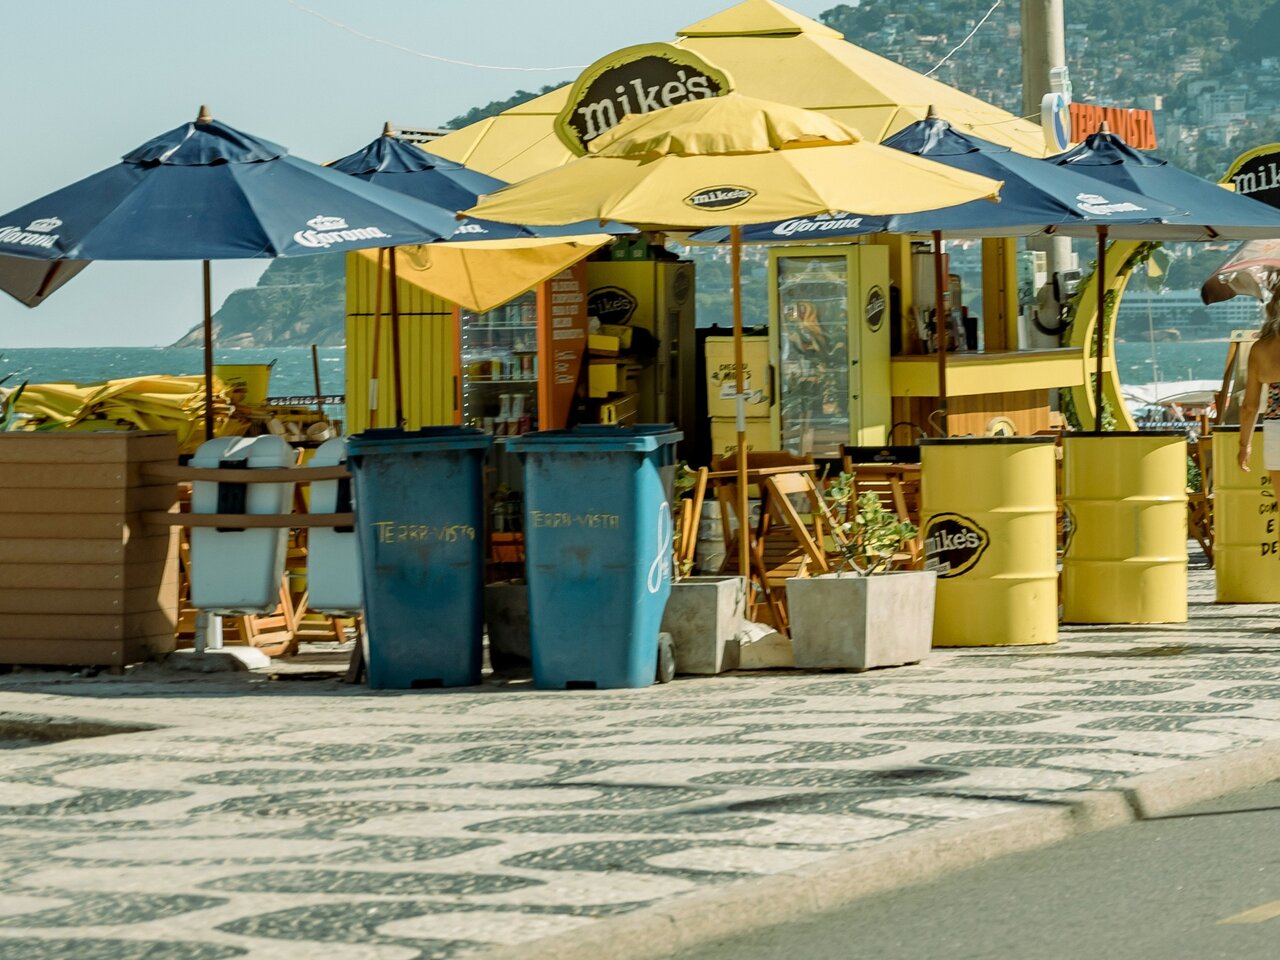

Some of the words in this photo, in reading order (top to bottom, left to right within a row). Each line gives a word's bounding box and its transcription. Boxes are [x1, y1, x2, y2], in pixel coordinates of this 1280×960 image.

[577, 70, 713, 140] mike's
[692, 188, 751, 205] mike's
[293, 226, 391, 248] Corona
[772, 217, 863, 237] Corona
